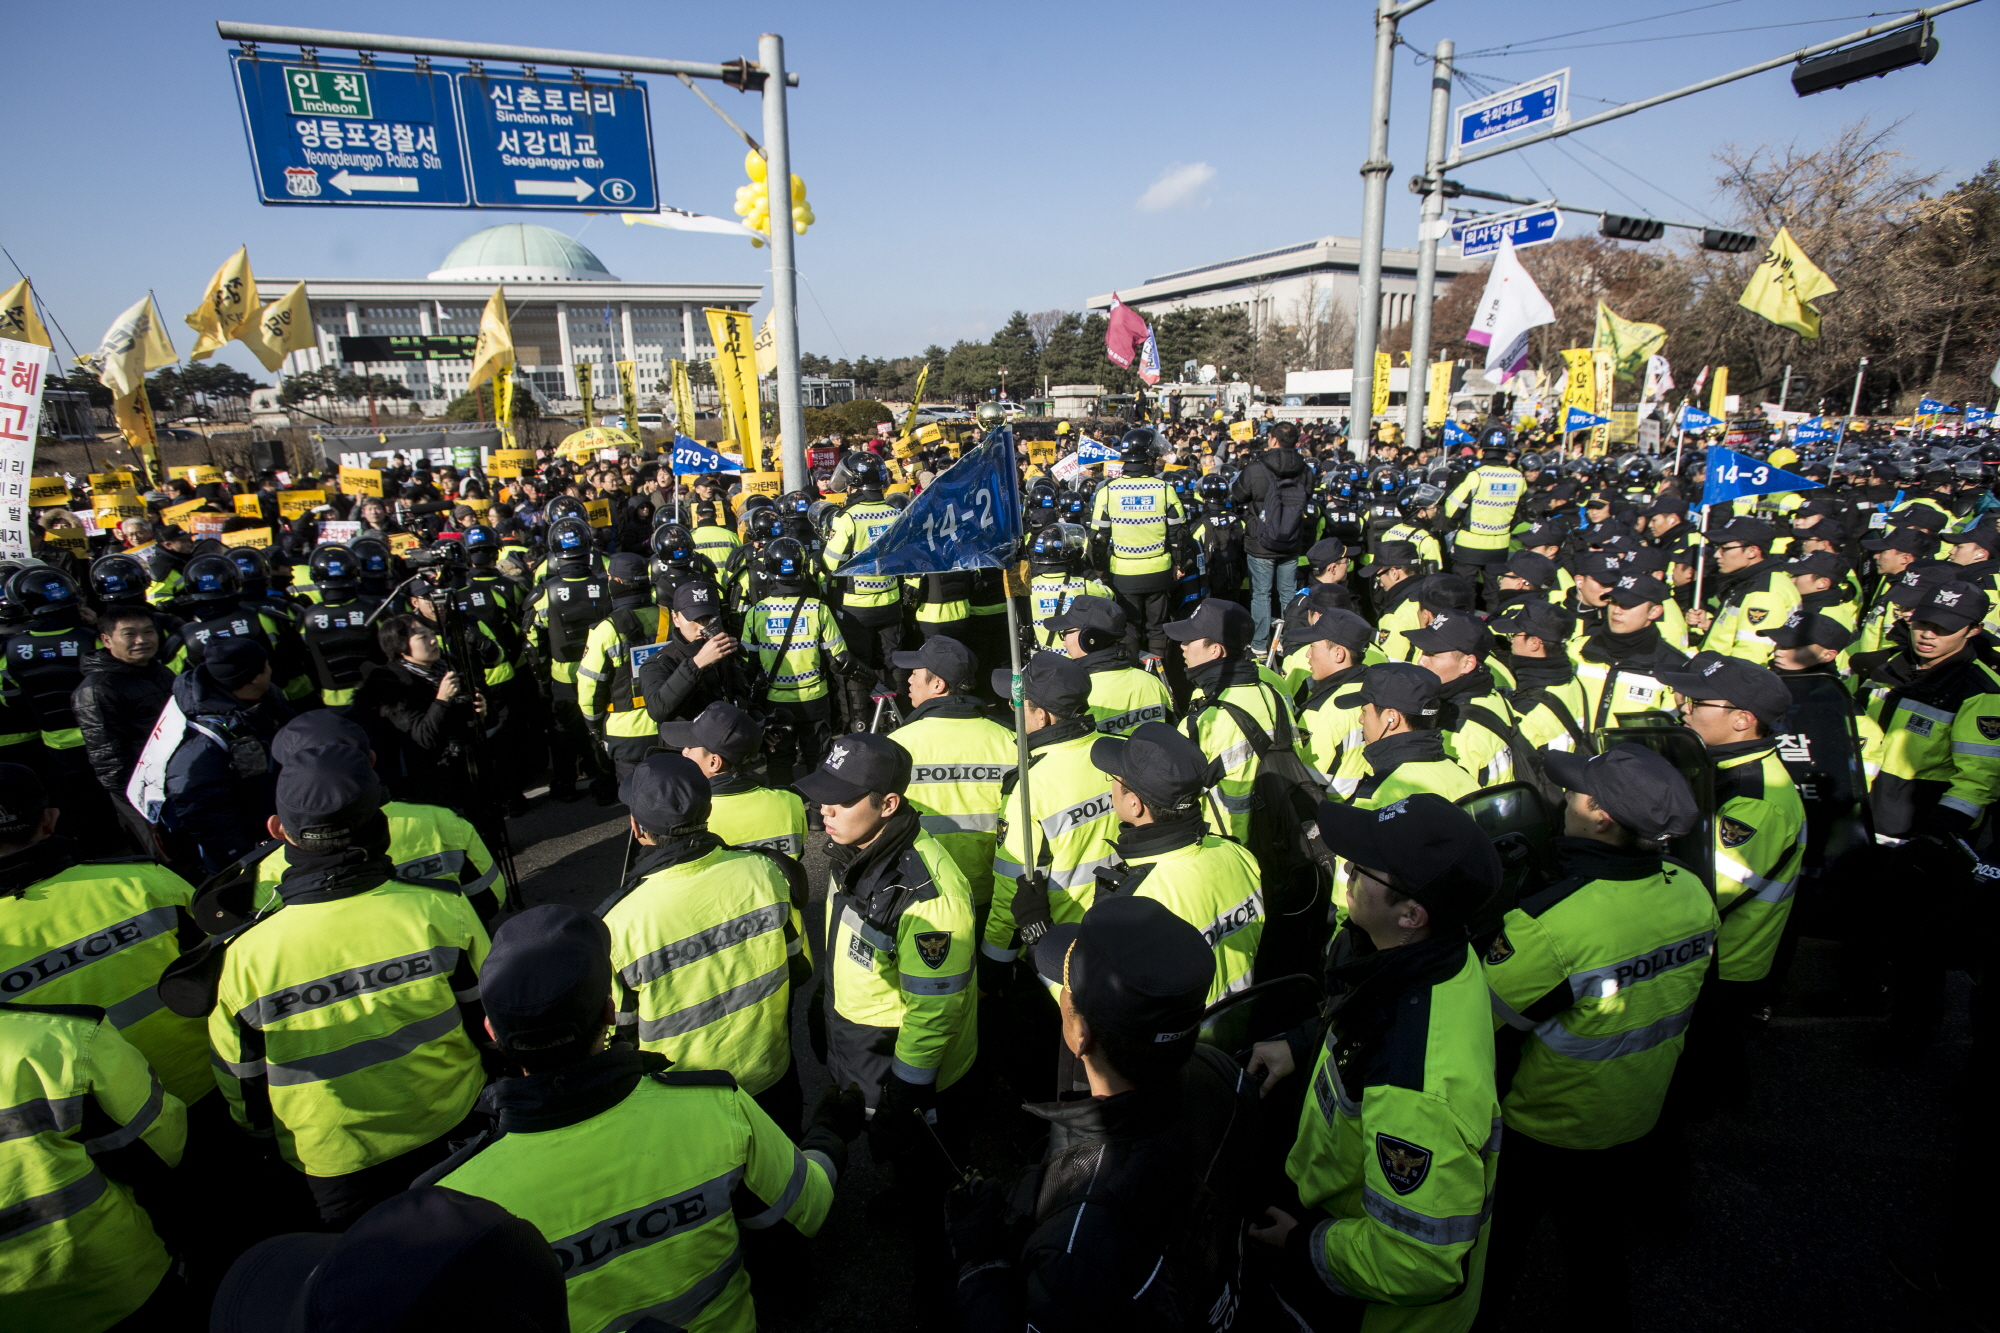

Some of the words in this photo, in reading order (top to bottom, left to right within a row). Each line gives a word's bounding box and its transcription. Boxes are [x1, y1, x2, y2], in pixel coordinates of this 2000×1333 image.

[302, 99, 358, 115] Incheon
[490, 85, 616, 117] 신촌로터리
[496, 110, 549, 125] Sinchon
[551, 113, 574, 126] Rot
[1480, 99, 1524, 125] 국회대로
[296, 119, 438, 154] 영등포경찰서
[497, 129, 598, 156] 서강대교
[302, 148, 383, 171] Yeongdeungpo
[386, 151, 419, 169] Police
[422, 154, 442, 170] Stn
[502, 154, 580, 170] Seoganggyo
[583, 158, 604, 169] (Br)
[290, 176, 316, 194] 120
[612, 182, 625, 200] 6
[675, 448, 719, 470] 279-3
[1079, 446, 1110, 460] 279-2
[500, 458, 534, 470] 즉각탄핵
[1716, 465, 1769, 485] 14-3
[29, 485, 68, 499] 각탄핵
[745, 480, 778, 493] 즉각탄핵
[922, 488, 994, 552] 14-2
[1103, 706, 1163, 732] POLICE
[1775, 733, 1812, 762] 찰
[914, 766, 1001, 781] POLICE
[661, 910, 774, 971] POLICE
[849, 951, 870, 968] POLICE
[1614, 937, 1707, 987] POLICE
[268, 953, 434, 1018] POLICE
[1390, 1172, 1411, 1185] POLICE
